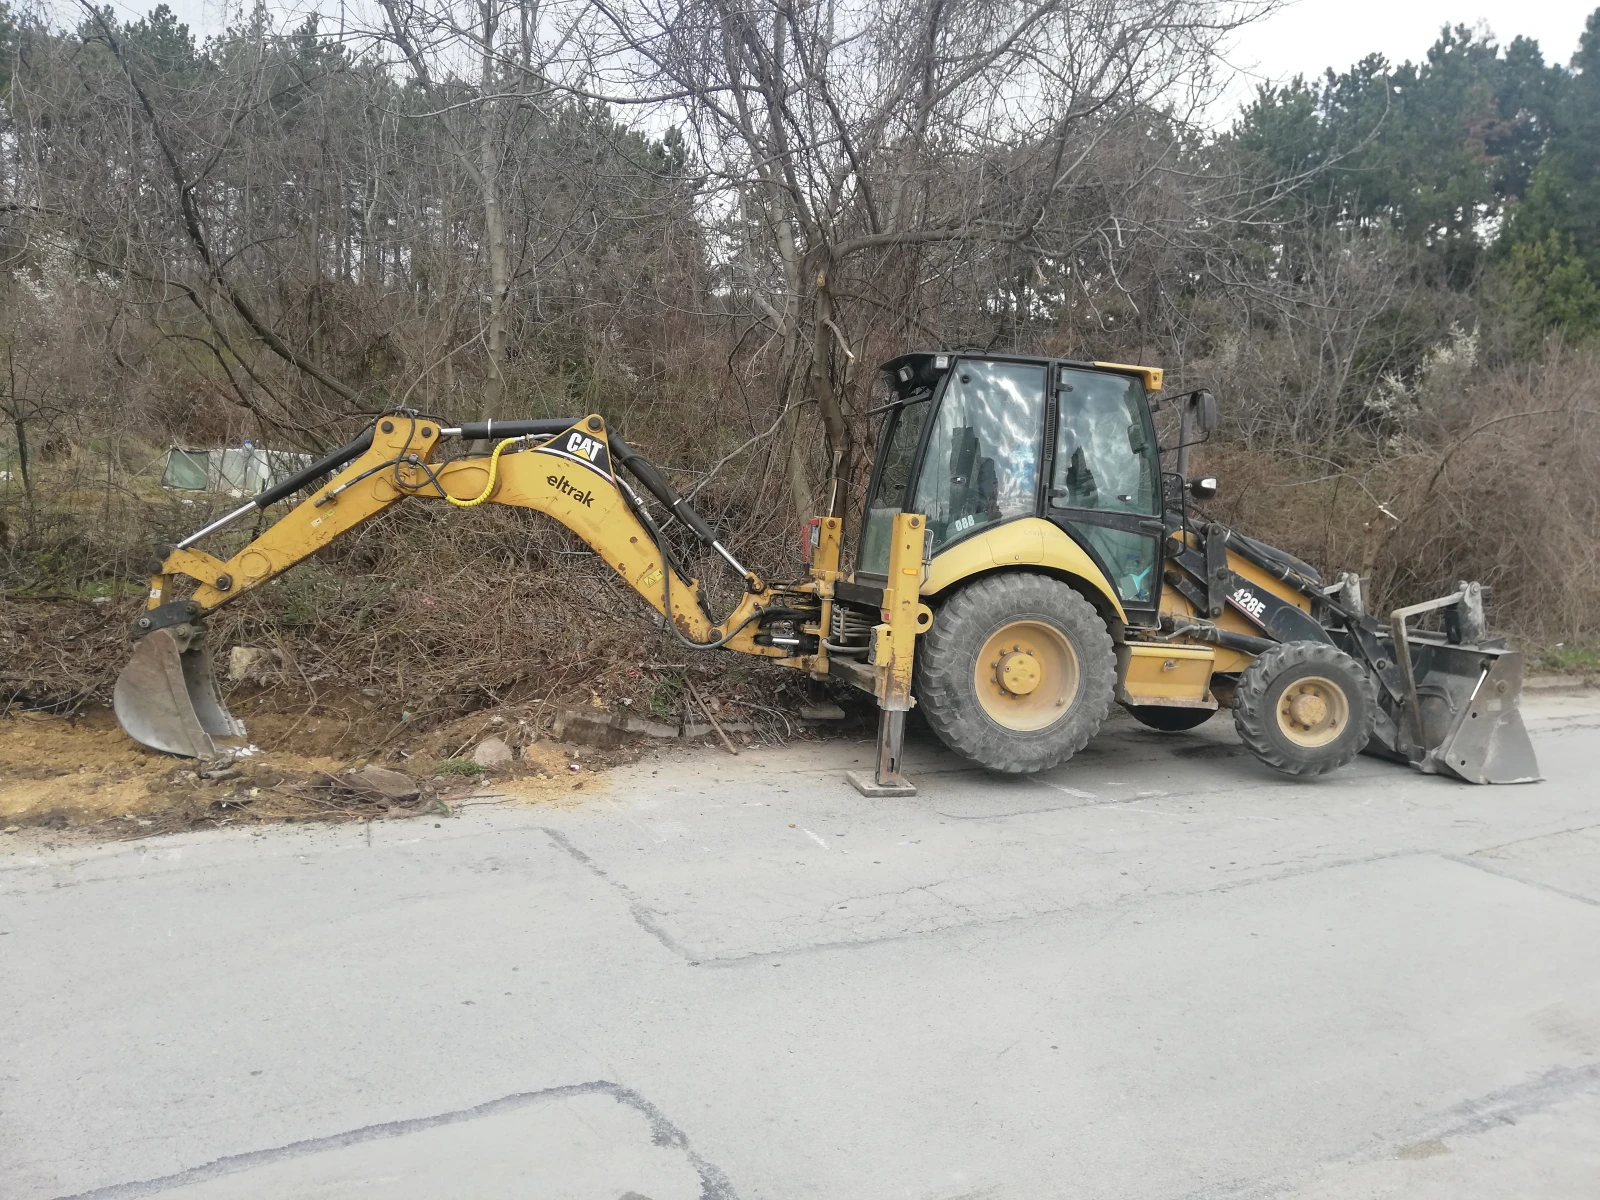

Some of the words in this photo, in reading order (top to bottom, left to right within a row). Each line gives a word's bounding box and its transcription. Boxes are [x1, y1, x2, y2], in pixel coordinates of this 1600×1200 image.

[566, 432, 604, 462] CAT
[546, 475, 595, 508] eltrak
[1233, 588, 1267, 618] 428E
